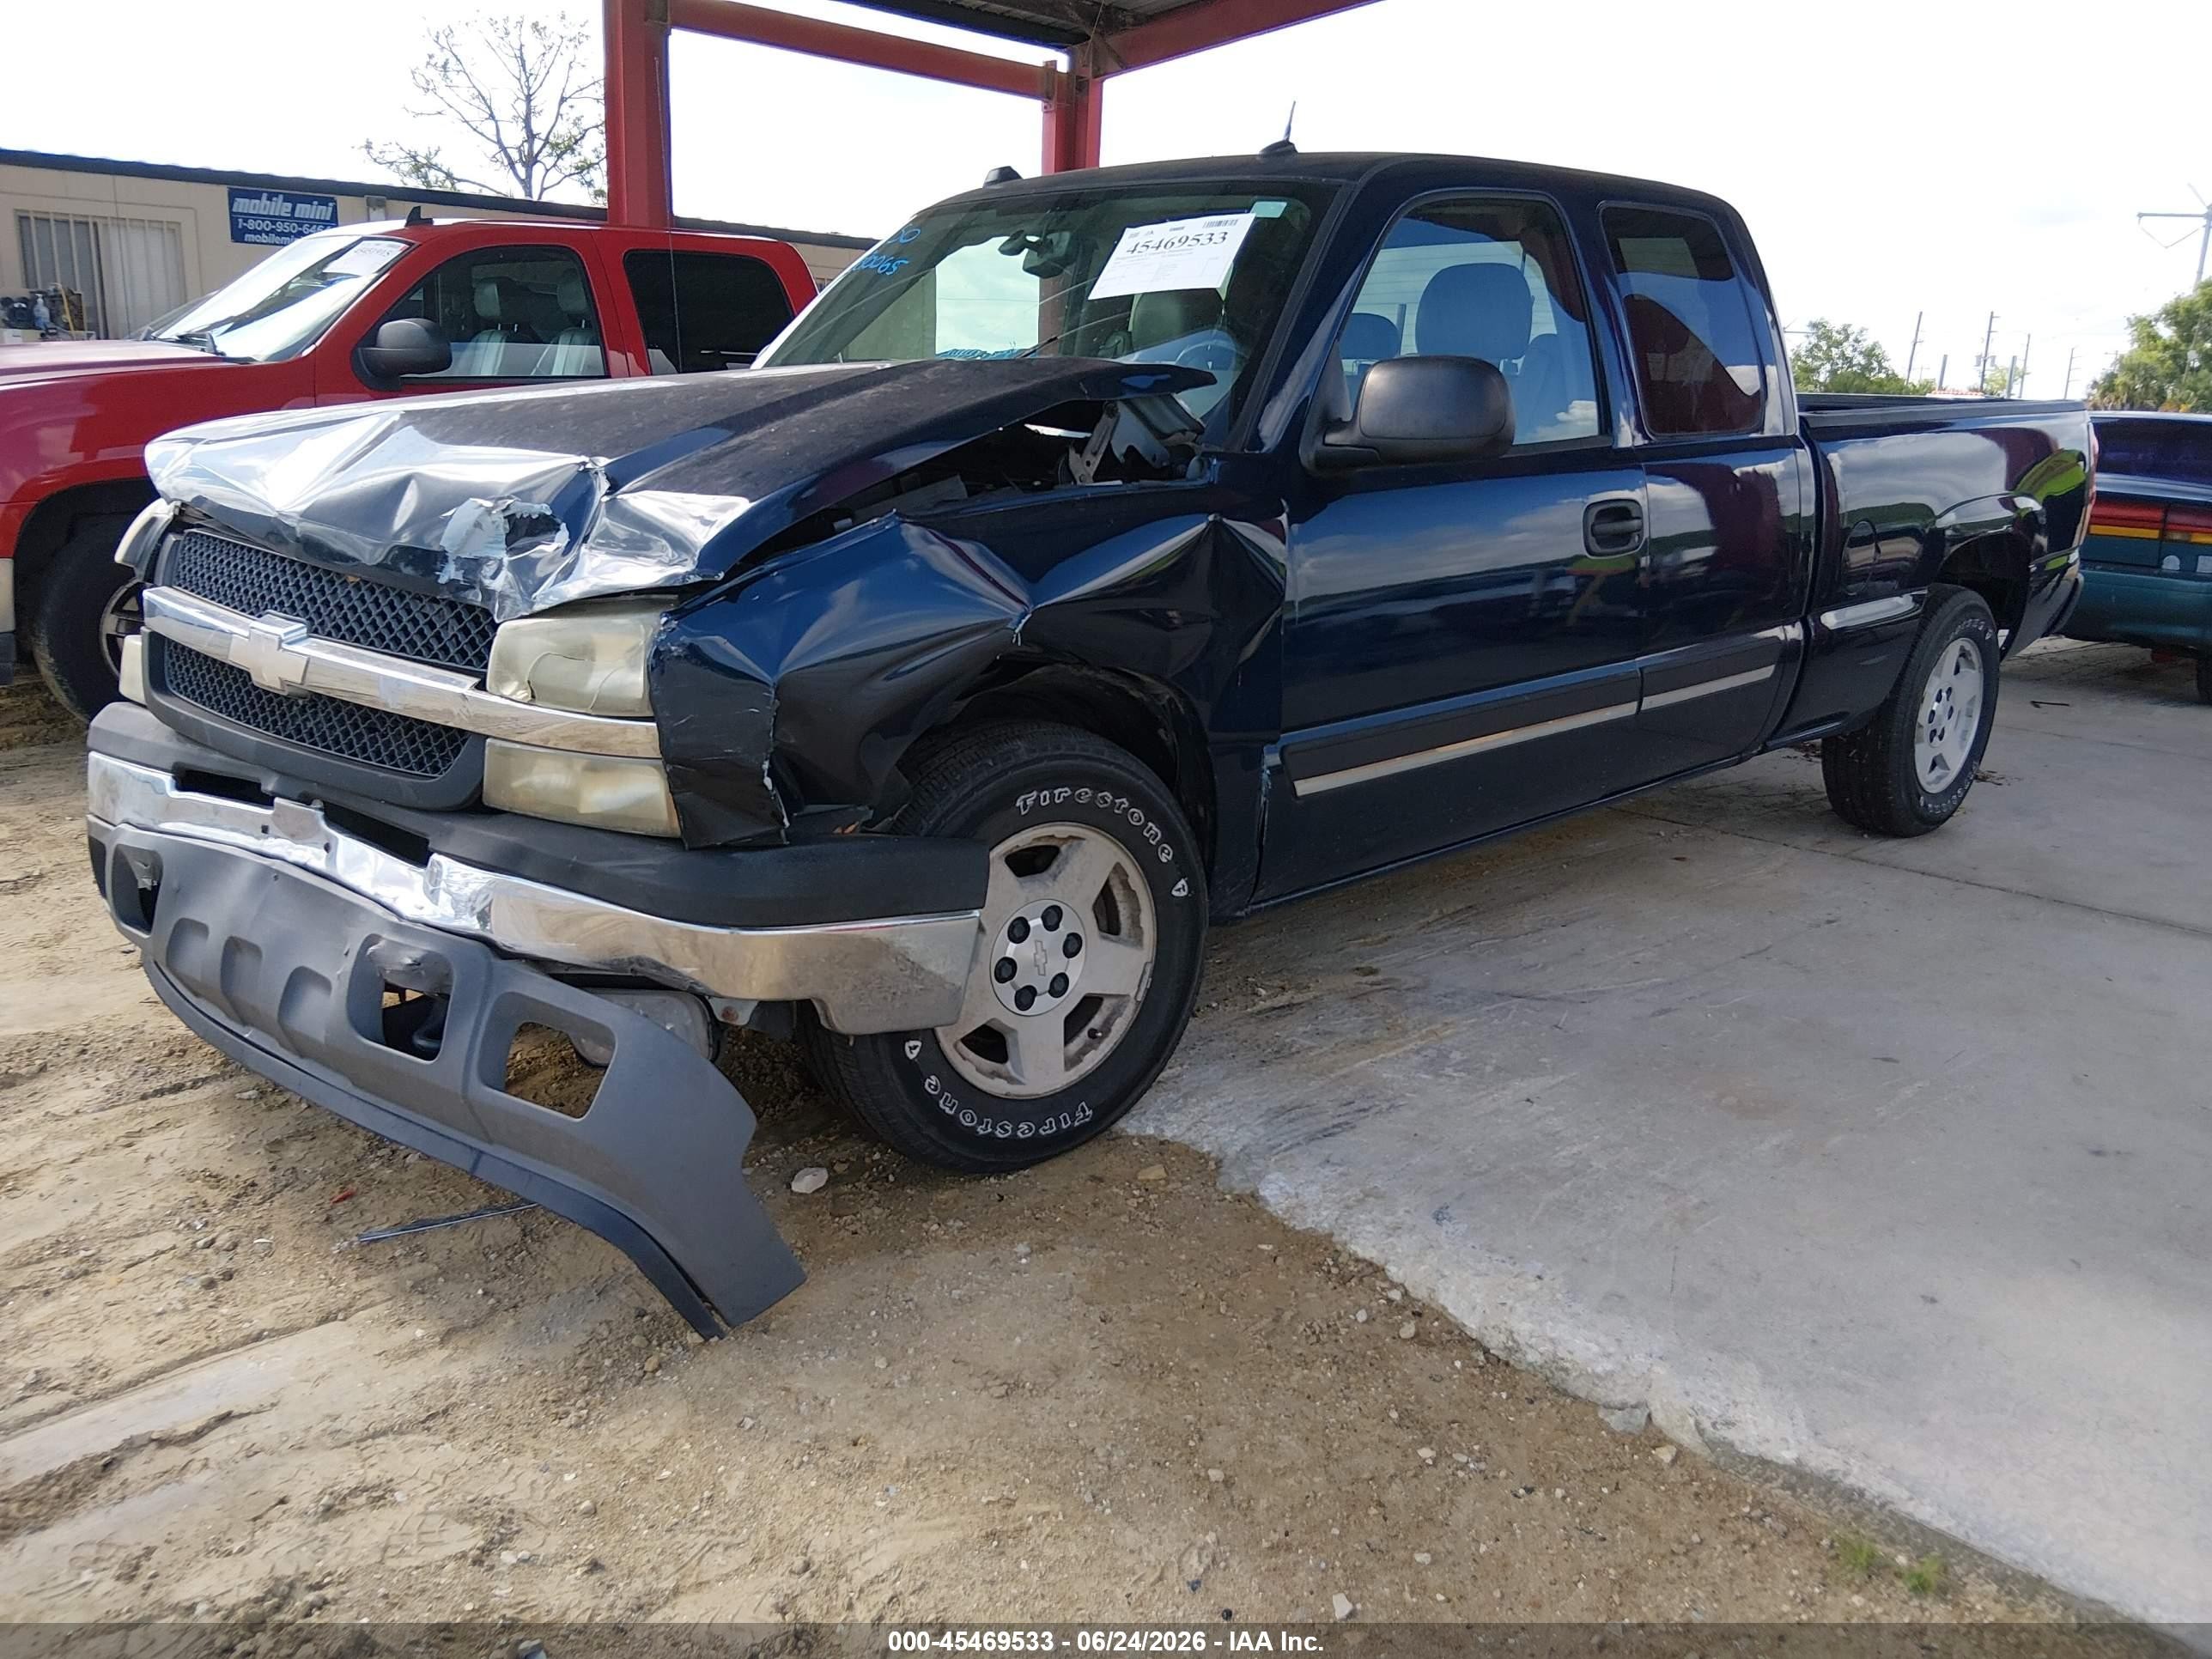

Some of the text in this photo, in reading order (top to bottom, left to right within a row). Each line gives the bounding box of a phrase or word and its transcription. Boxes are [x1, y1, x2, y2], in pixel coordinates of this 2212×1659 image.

[232, 193, 333, 220] mobile mini
[238, 218, 331, 234] 1-800-950-646
[1127, 231, 1228, 255] 45469533
[1016, 787, 1173, 862] Firestone
[924, 1075, 1092, 1138] Firestone
